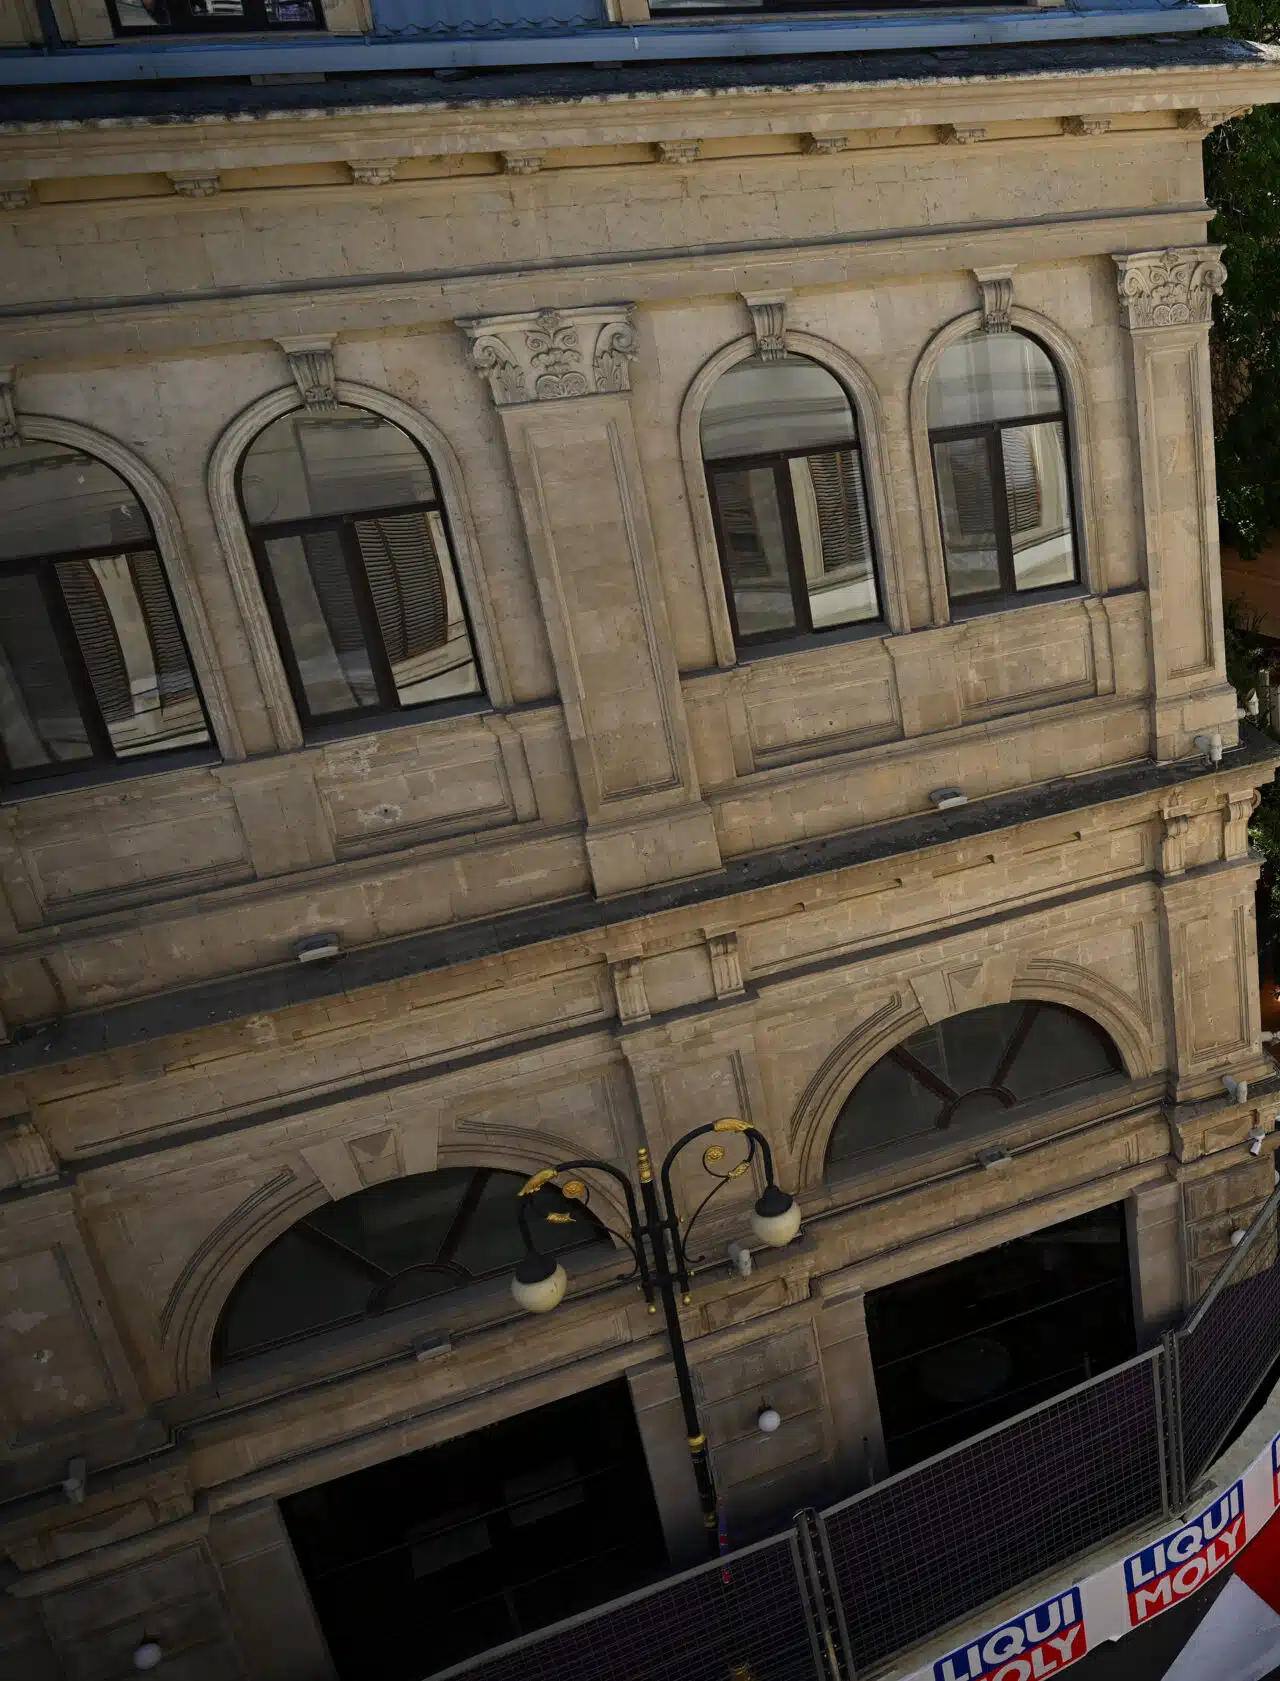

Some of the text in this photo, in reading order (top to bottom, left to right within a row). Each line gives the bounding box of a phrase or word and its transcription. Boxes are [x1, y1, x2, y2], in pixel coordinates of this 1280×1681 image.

[1132, 1486, 1240, 1583] LIQUI
[1136, 1518, 1242, 1620] MOLY
[941, 1592, 1076, 1681] LIQUI
[977, 1624, 1081, 1681] OLY
